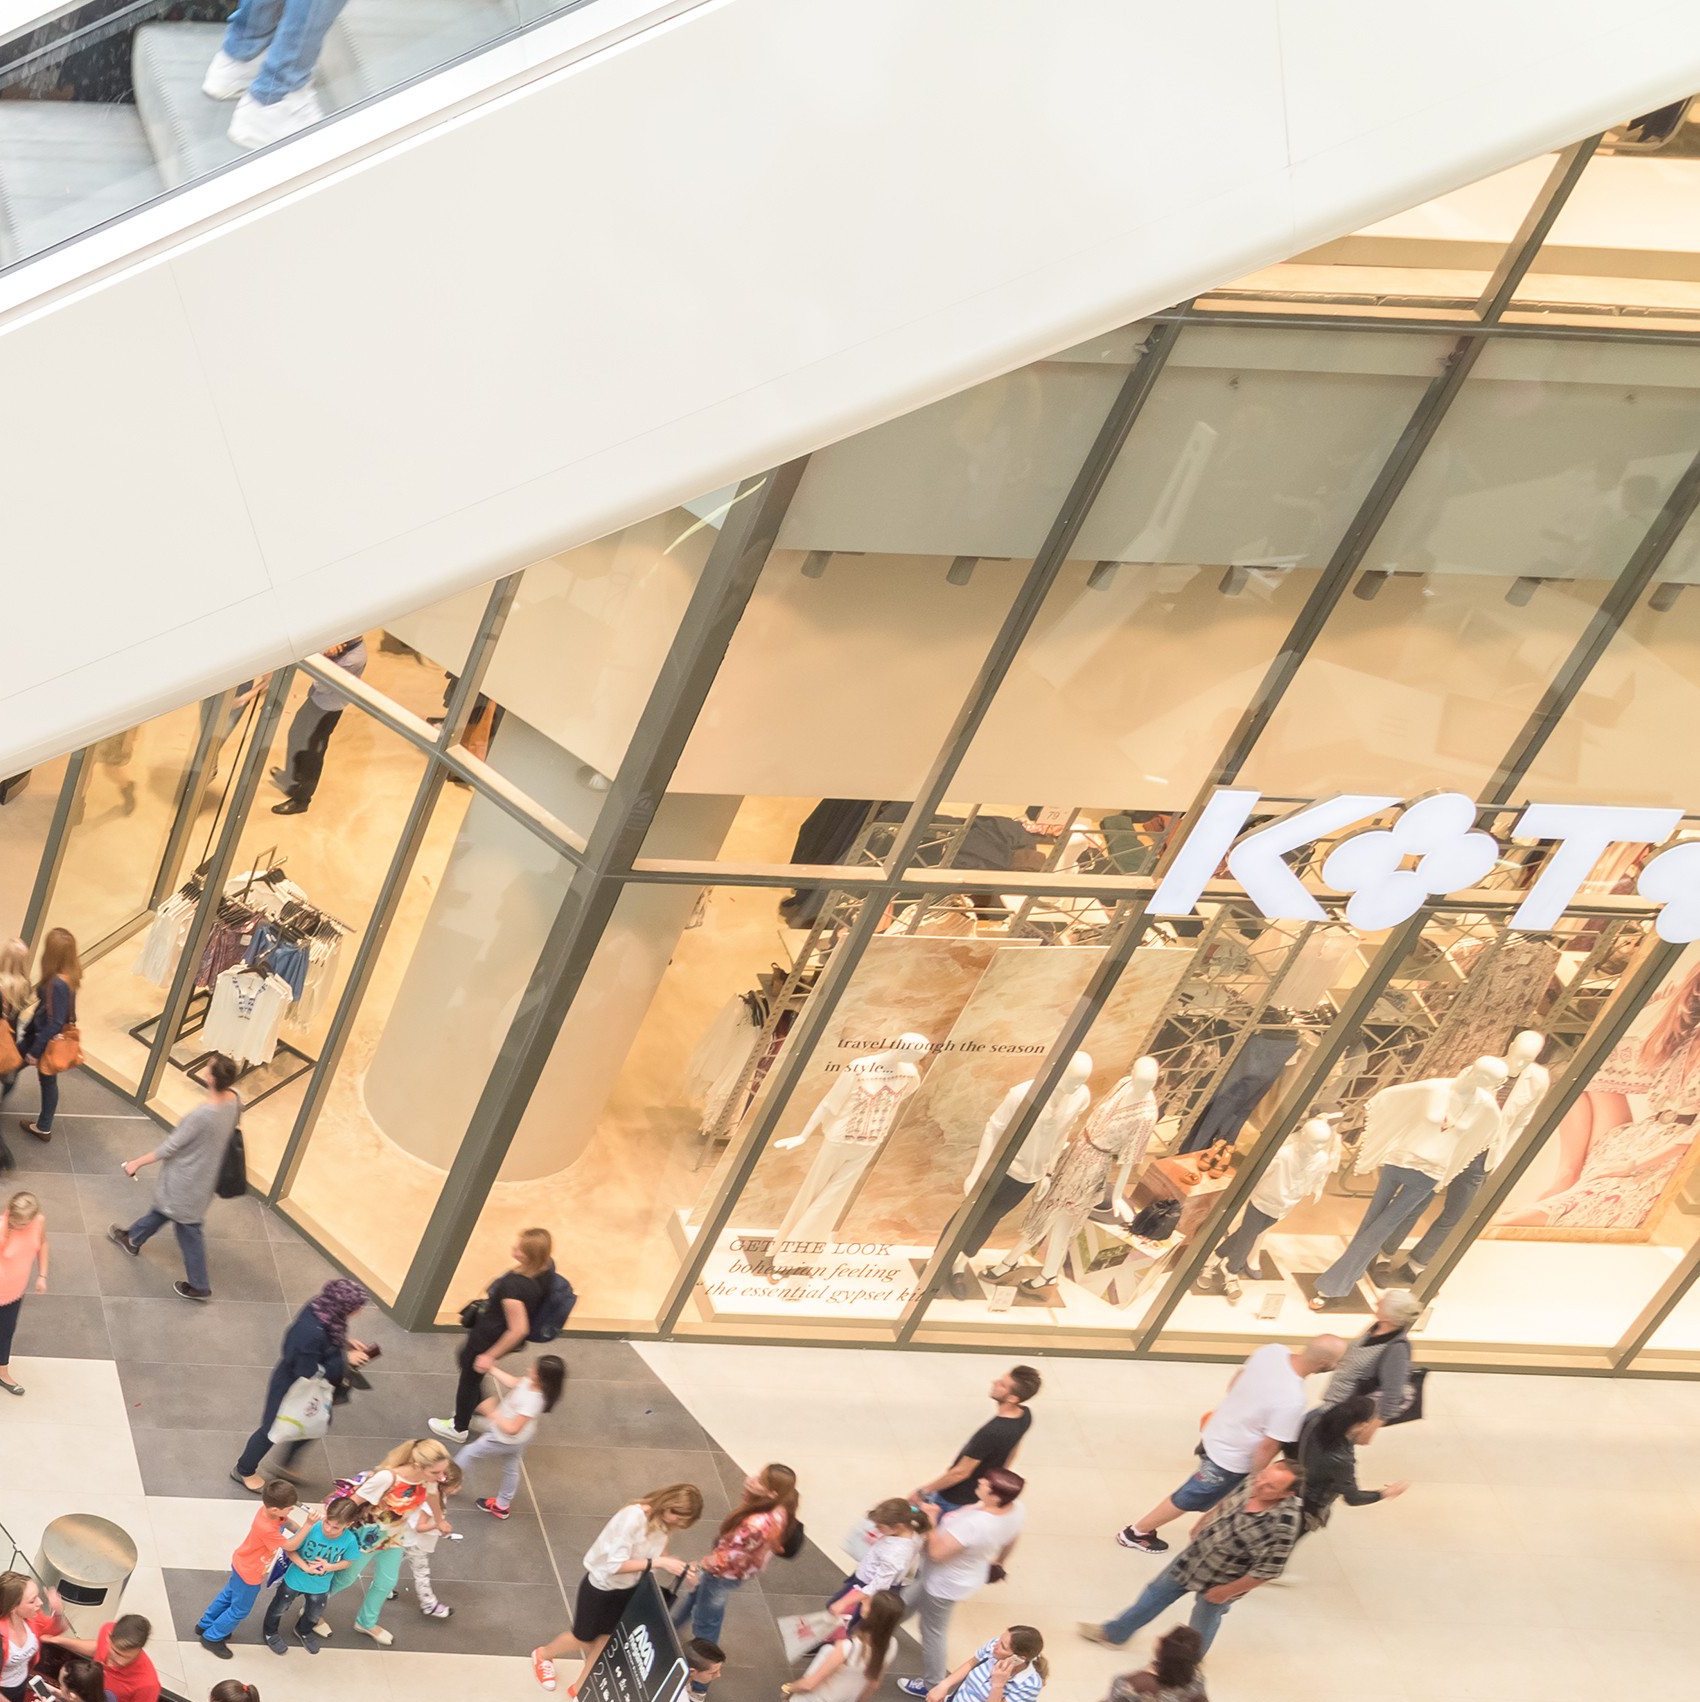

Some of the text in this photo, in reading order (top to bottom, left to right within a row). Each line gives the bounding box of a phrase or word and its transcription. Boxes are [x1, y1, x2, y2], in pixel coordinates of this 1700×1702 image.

[837, 1038, 1046, 1055] travel through the season
[824, 1061, 894, 1076] in style...
[729, 1239, 894, 1256] GET THE LOOK
[728, 1259, 902, 1283] bohemian feeling
[741, 1284, 831, 1300] essential
[826, 1288, 893, 1304] gypset
[304, 1540, 345, 1563] STAY
[607, 1637, 620, 1659] 3
[593, 1661, 605, 1682] 2
